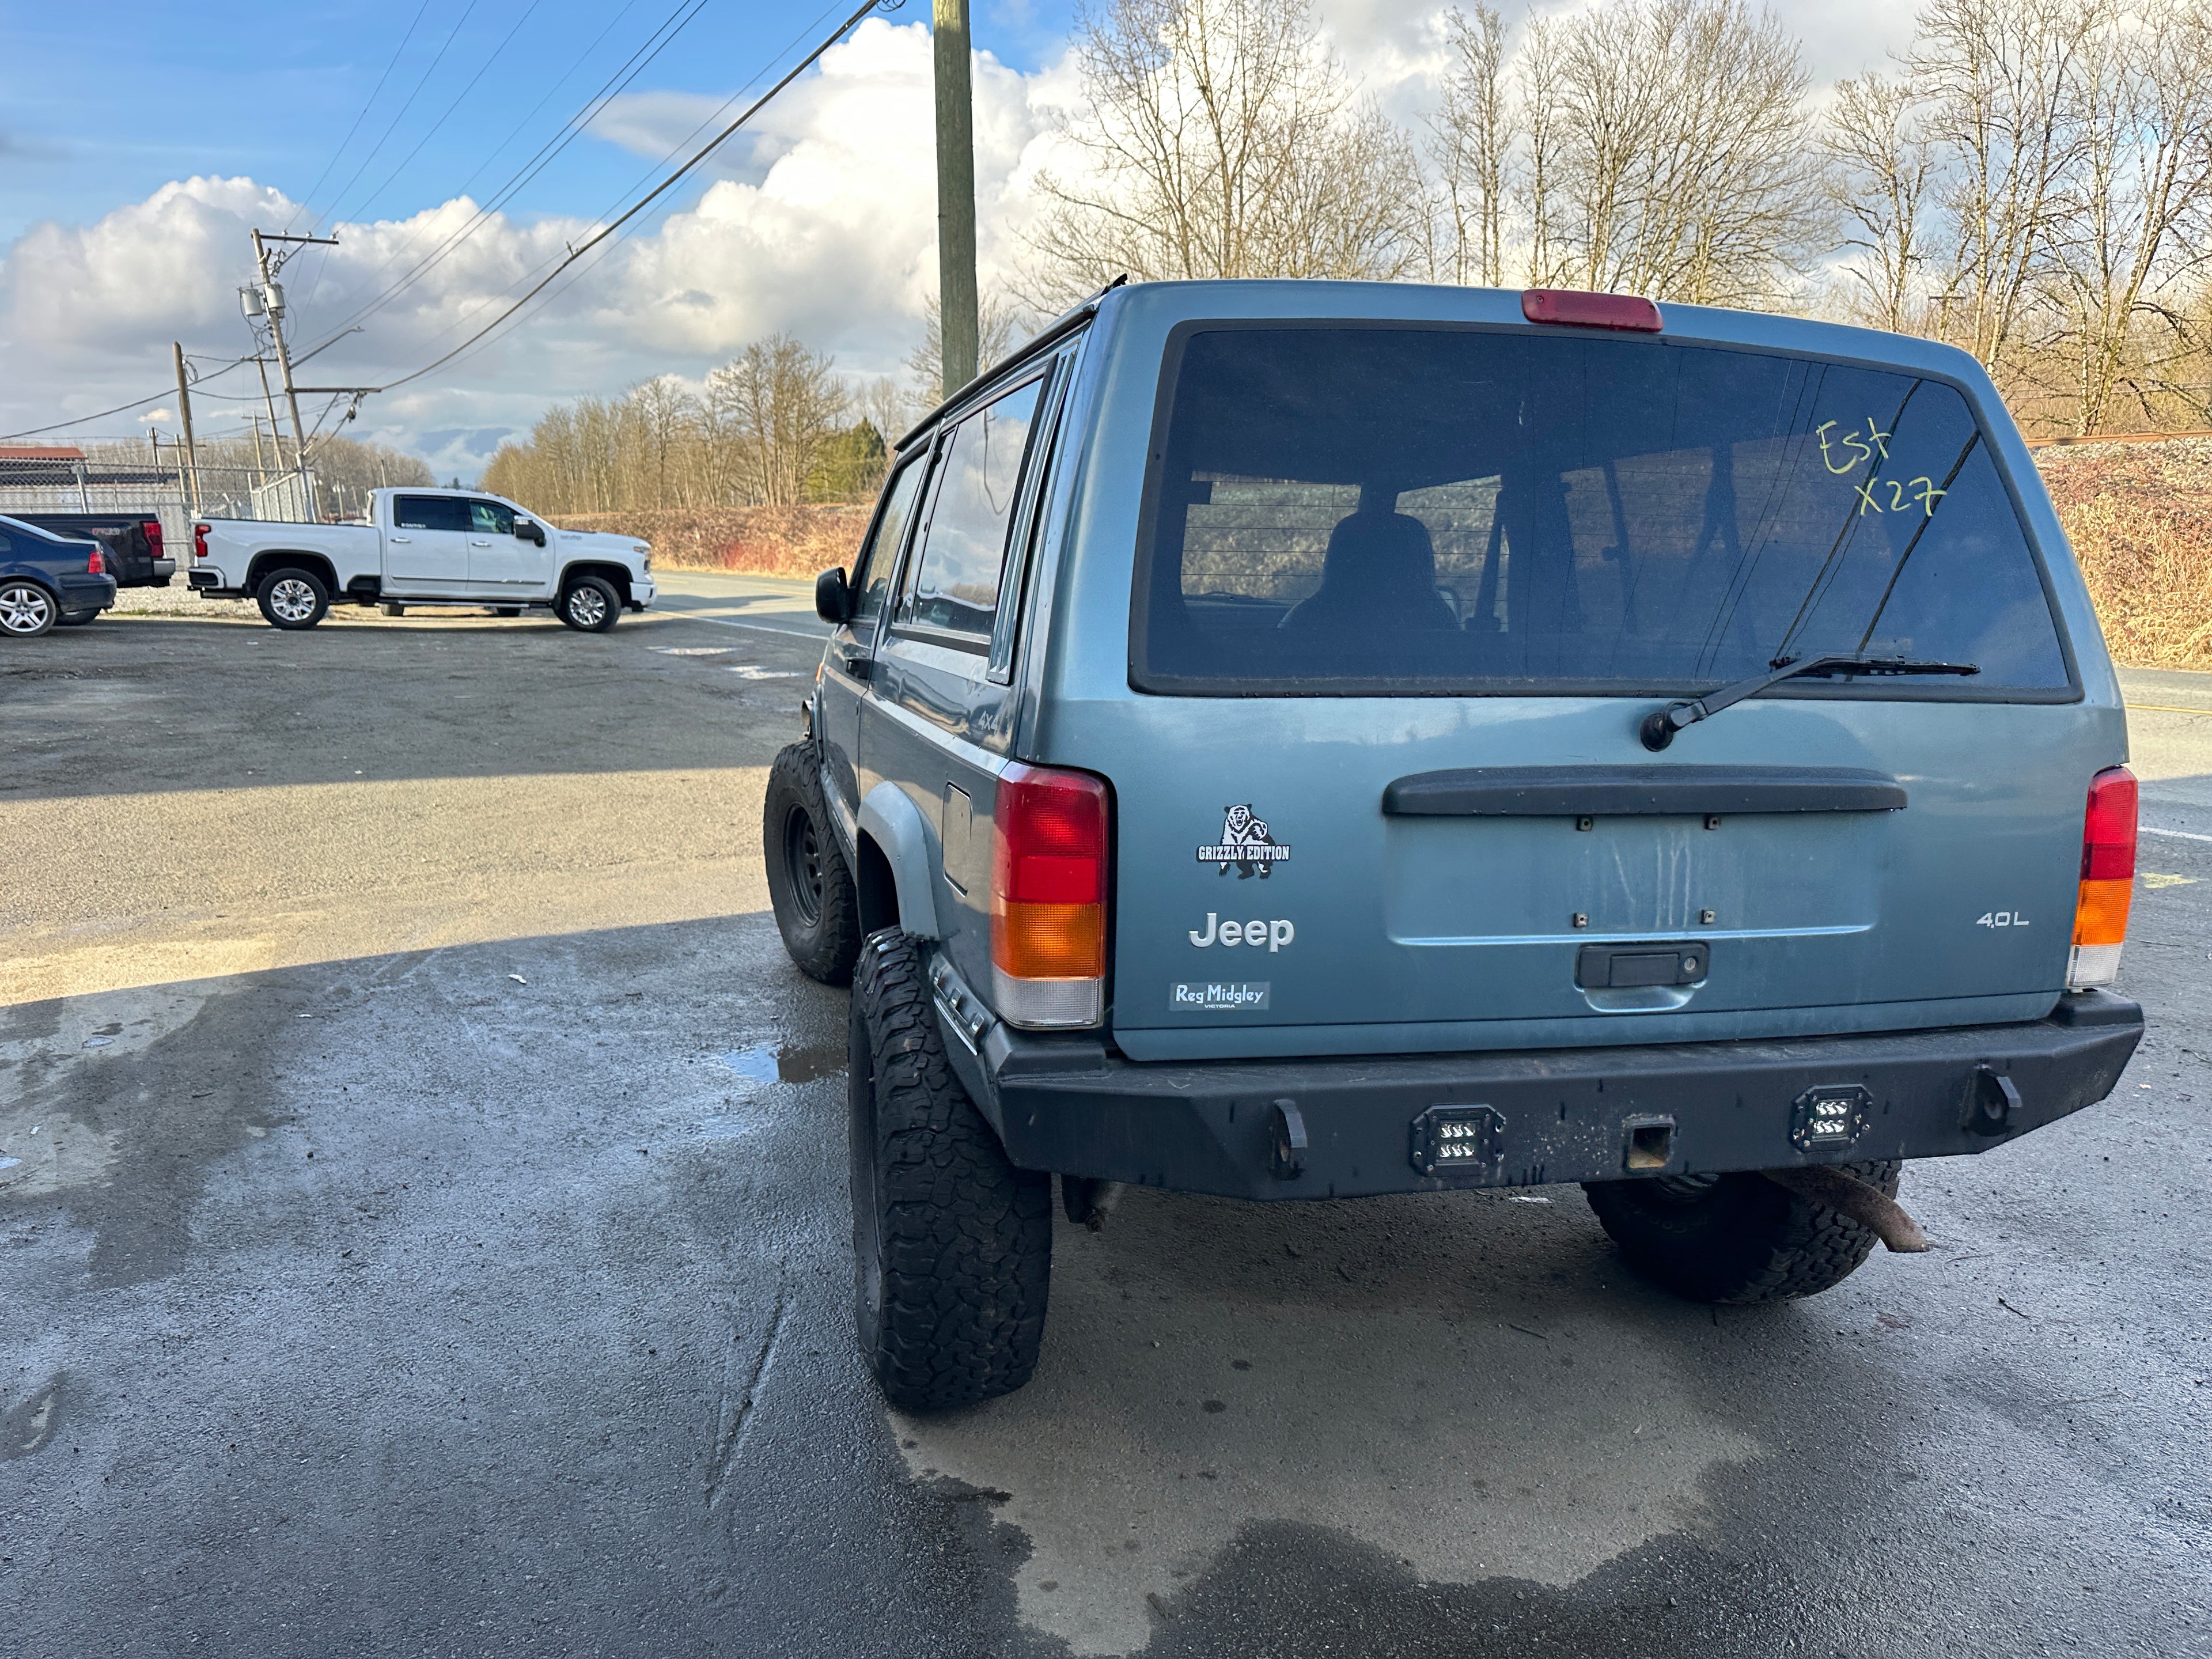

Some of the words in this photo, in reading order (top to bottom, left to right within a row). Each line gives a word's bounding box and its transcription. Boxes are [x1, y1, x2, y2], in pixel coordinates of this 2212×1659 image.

[1816, 417, 1892, 474] Est
[1198, 845, 1244, 860] GRIZZLY
[1247, 845, 1290, 860] EDITION
[1188, 912, 1295, 953] Jeep
[1176, 984, 1204, 1003] Reg
[1207, 984, 1264, 1003] Midgley
